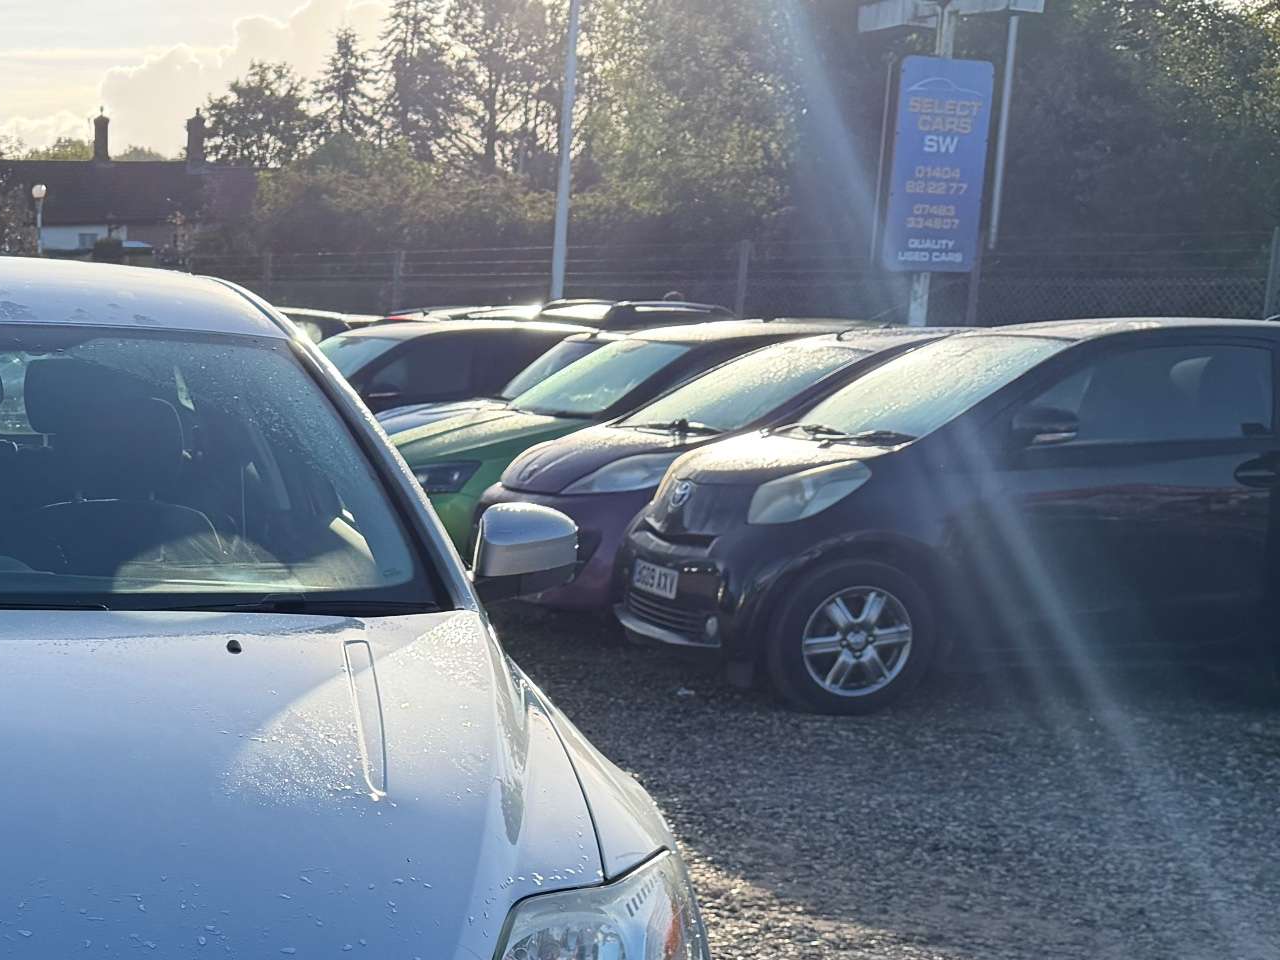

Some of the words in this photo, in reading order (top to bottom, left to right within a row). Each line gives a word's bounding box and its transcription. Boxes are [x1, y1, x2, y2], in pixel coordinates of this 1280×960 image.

[909, 97, 983, 117] SELECT
[917, 115, 972, 133] CARS
[923, 134, 959, 153] SW
[915, 166, 961, 178] 01404
[907, 238, 955, 249] QUALITY
[898, 251, 930, 261] USED
[931, 252, 963, 262] CARS
